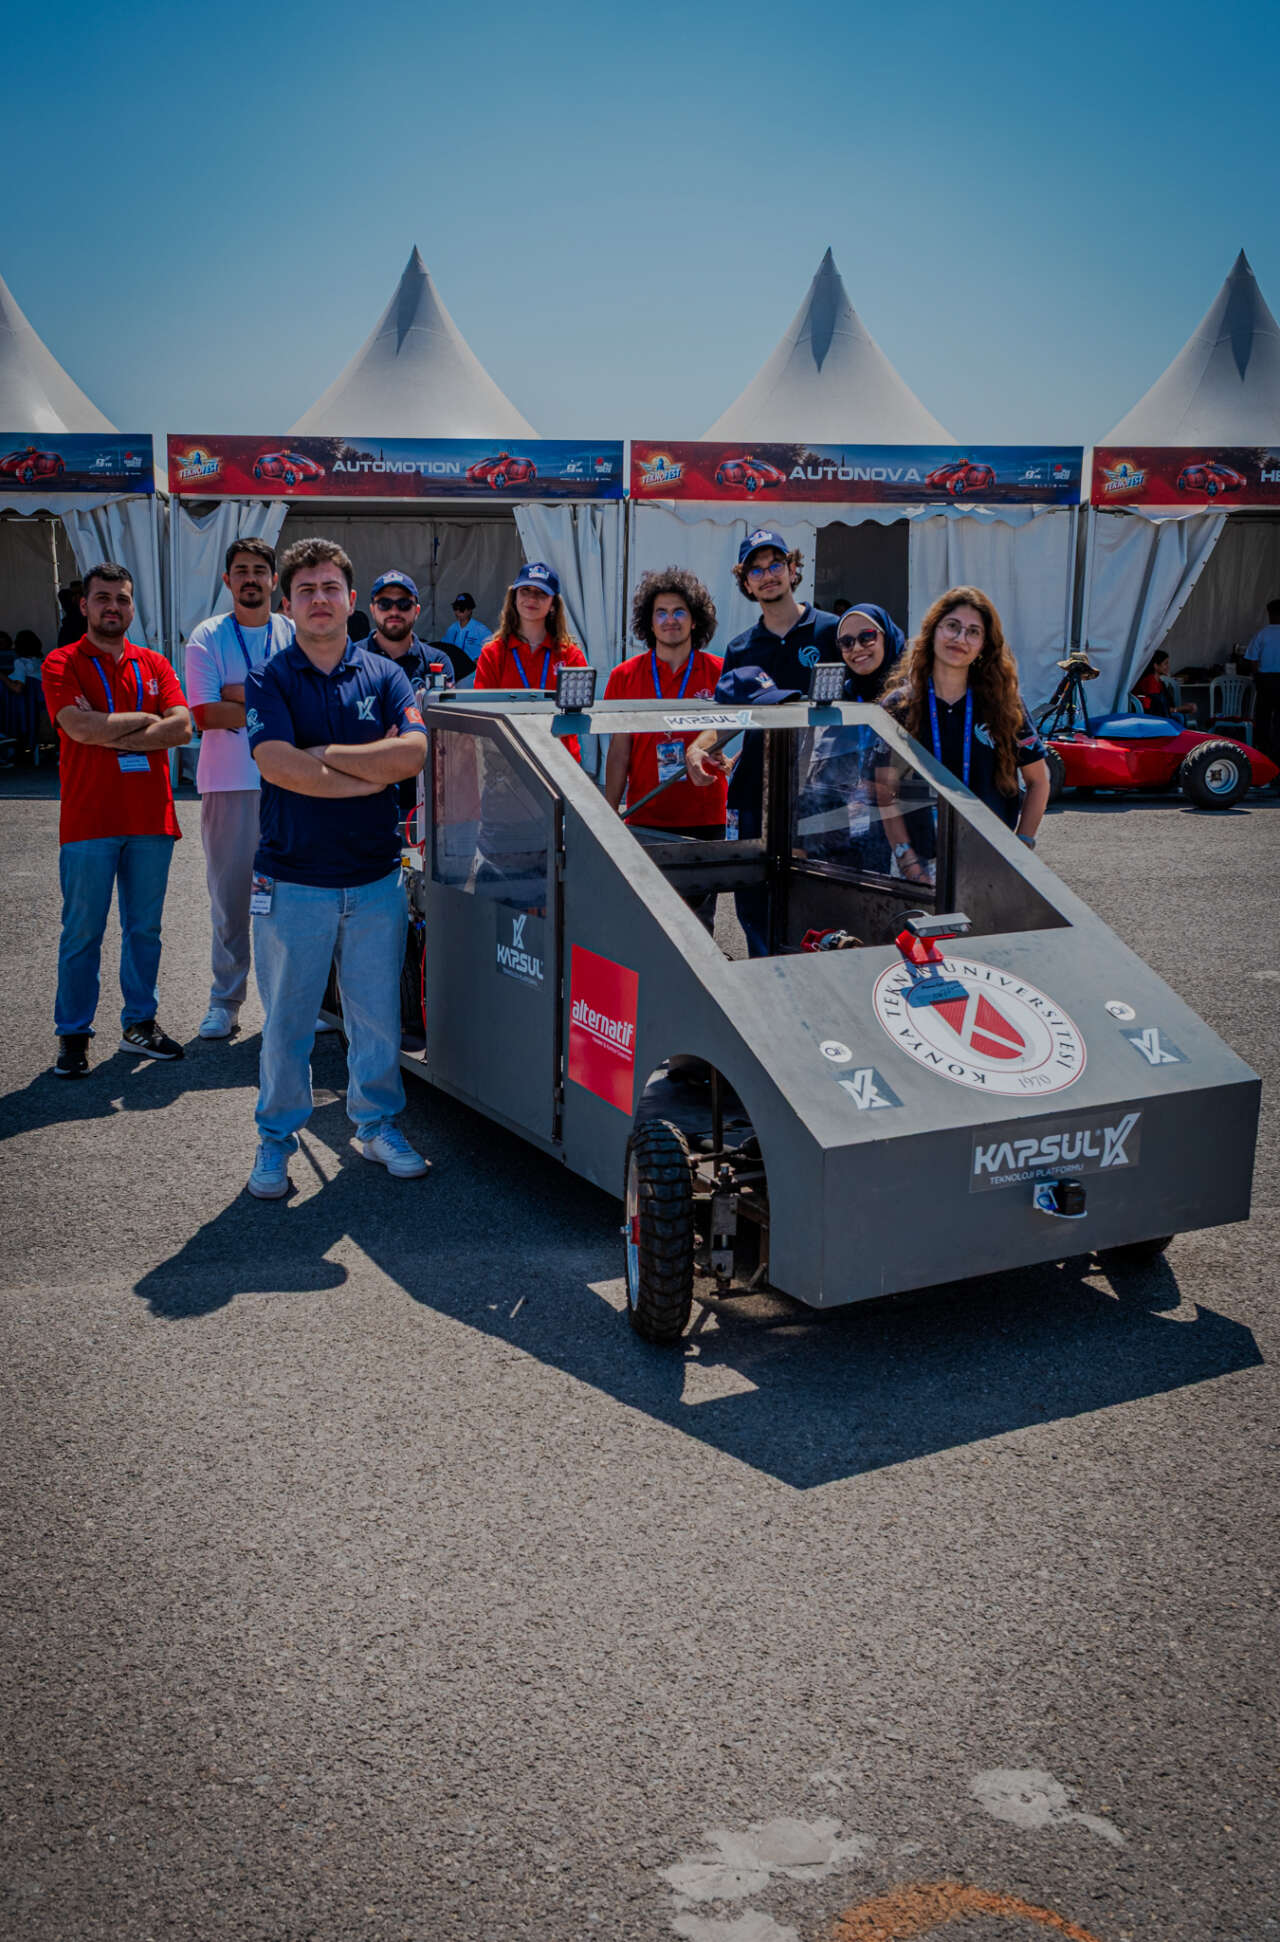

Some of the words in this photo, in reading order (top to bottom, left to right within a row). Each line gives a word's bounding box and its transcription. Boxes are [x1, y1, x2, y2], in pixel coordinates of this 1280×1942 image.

[332, 461, 460, 473] AUTOMOTION
[789, 466, 921, 481] AUTONOVA
[666, 714, 737, 725] KAPSUL
[497, 943, 544, 980] KAPSUL
[572, 999, 633, 1047] alternatif
[900, 1028, 986, 1084] KONYA
[1018, 1074, 1051, 1088] 1970
[974, 1130, 1100, 1175] KAPSUL
[1035, 1163, 1084, 1178] PLATFORMU
